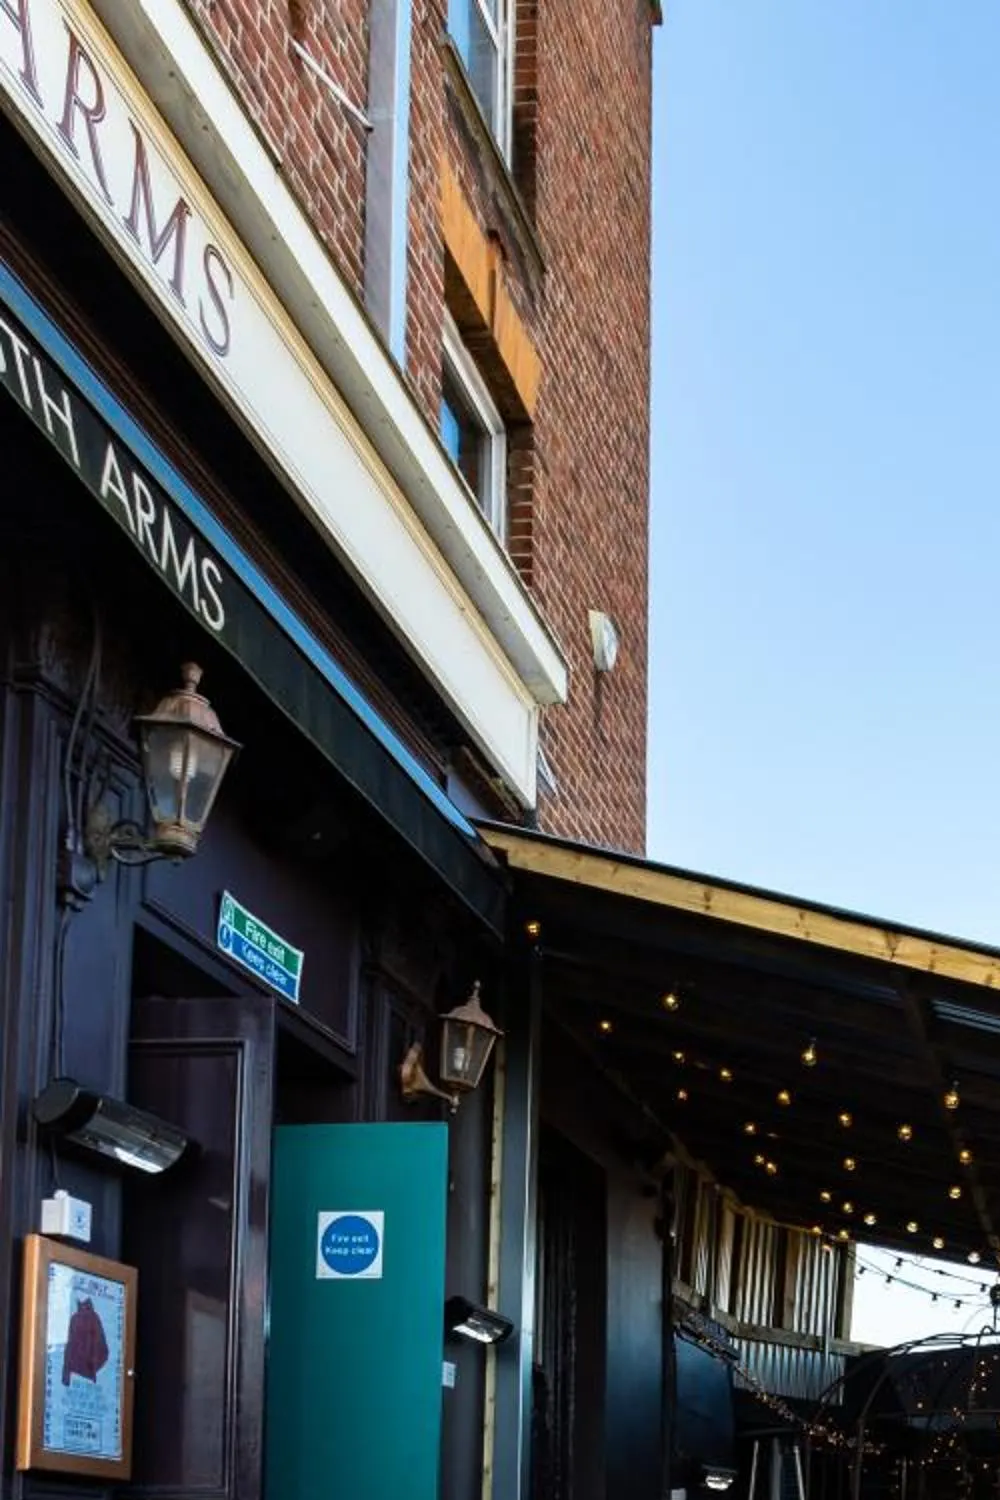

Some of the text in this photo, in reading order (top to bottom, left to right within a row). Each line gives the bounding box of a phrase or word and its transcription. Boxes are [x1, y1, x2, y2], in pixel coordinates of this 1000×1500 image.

[0, 318, 224, 631] TH ARMS
[245, 919, 266, 949] Fire
